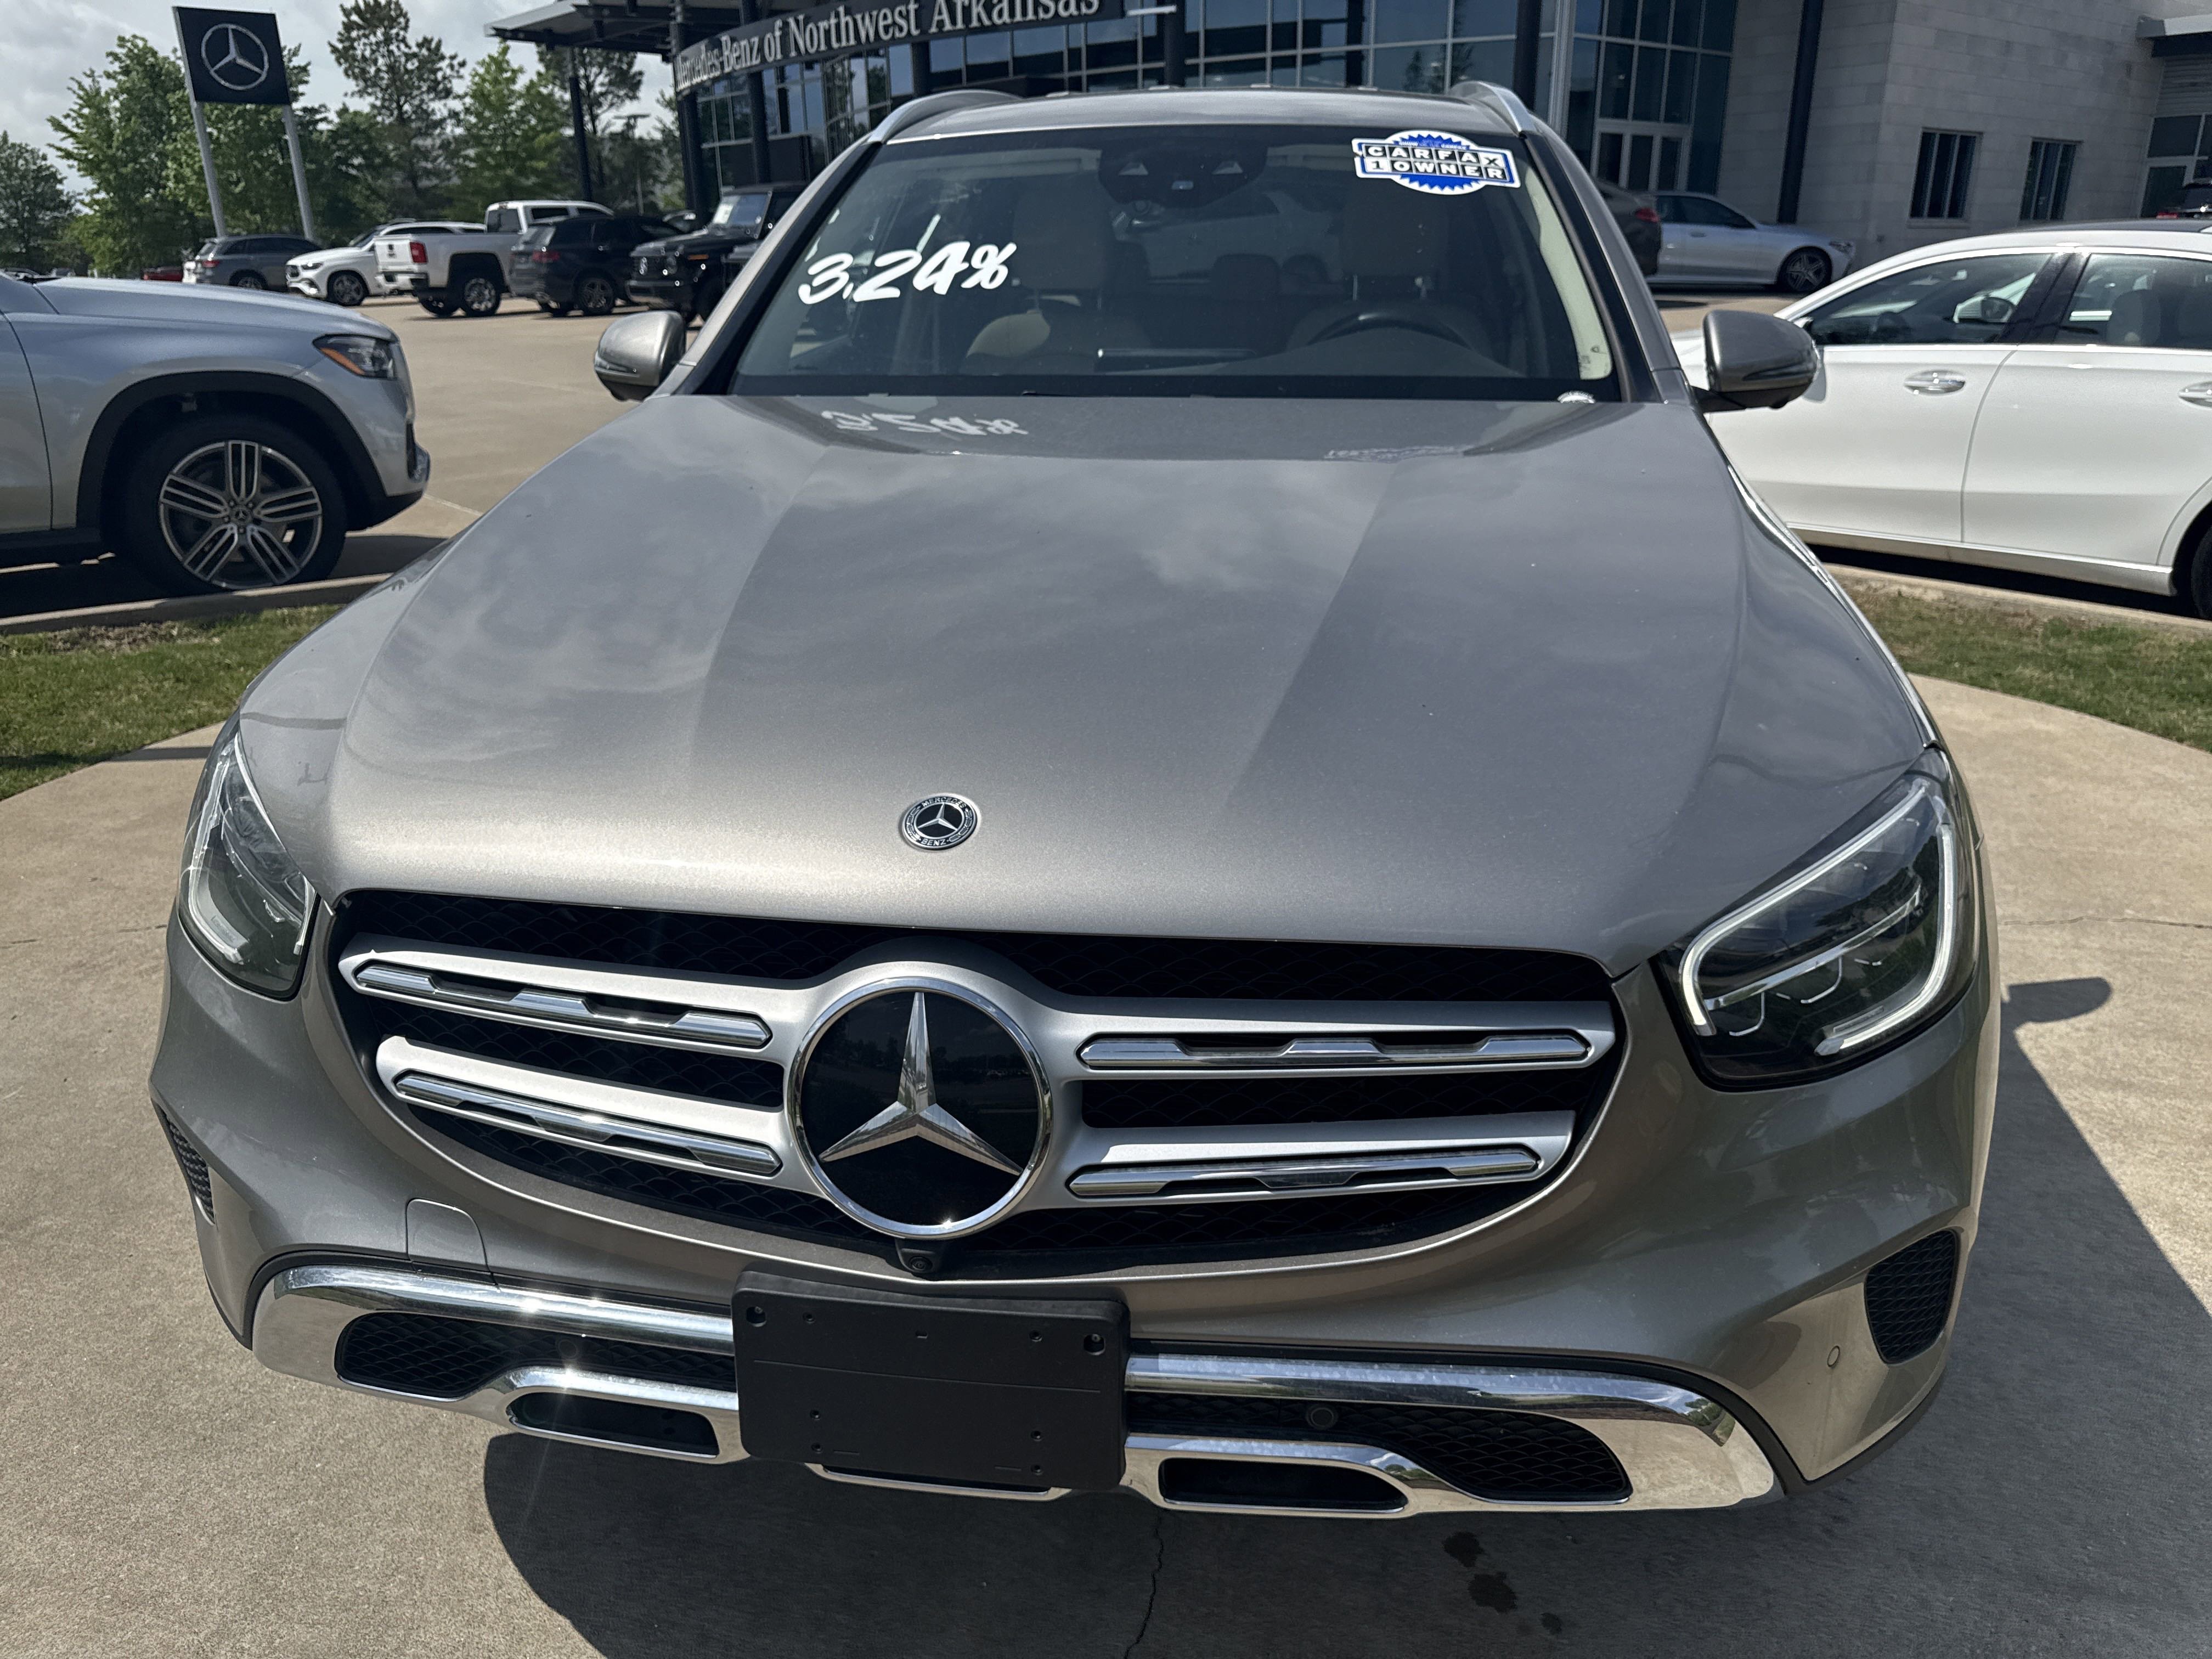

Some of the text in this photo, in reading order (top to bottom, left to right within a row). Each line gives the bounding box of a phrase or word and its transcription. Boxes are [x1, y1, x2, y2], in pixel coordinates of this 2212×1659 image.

[764, 19, 783, 63] of
[787, 0, 921, 57] Northwest
[1367, 145, 1502, 167] CARFAX
[1371, 159, 1503, 178] 1 OWNER
[798, 240, 1017, 305] 3.24%
[921, 797, 967, 809] MERCEDES
[921, 838, 947, 847] BENZ
